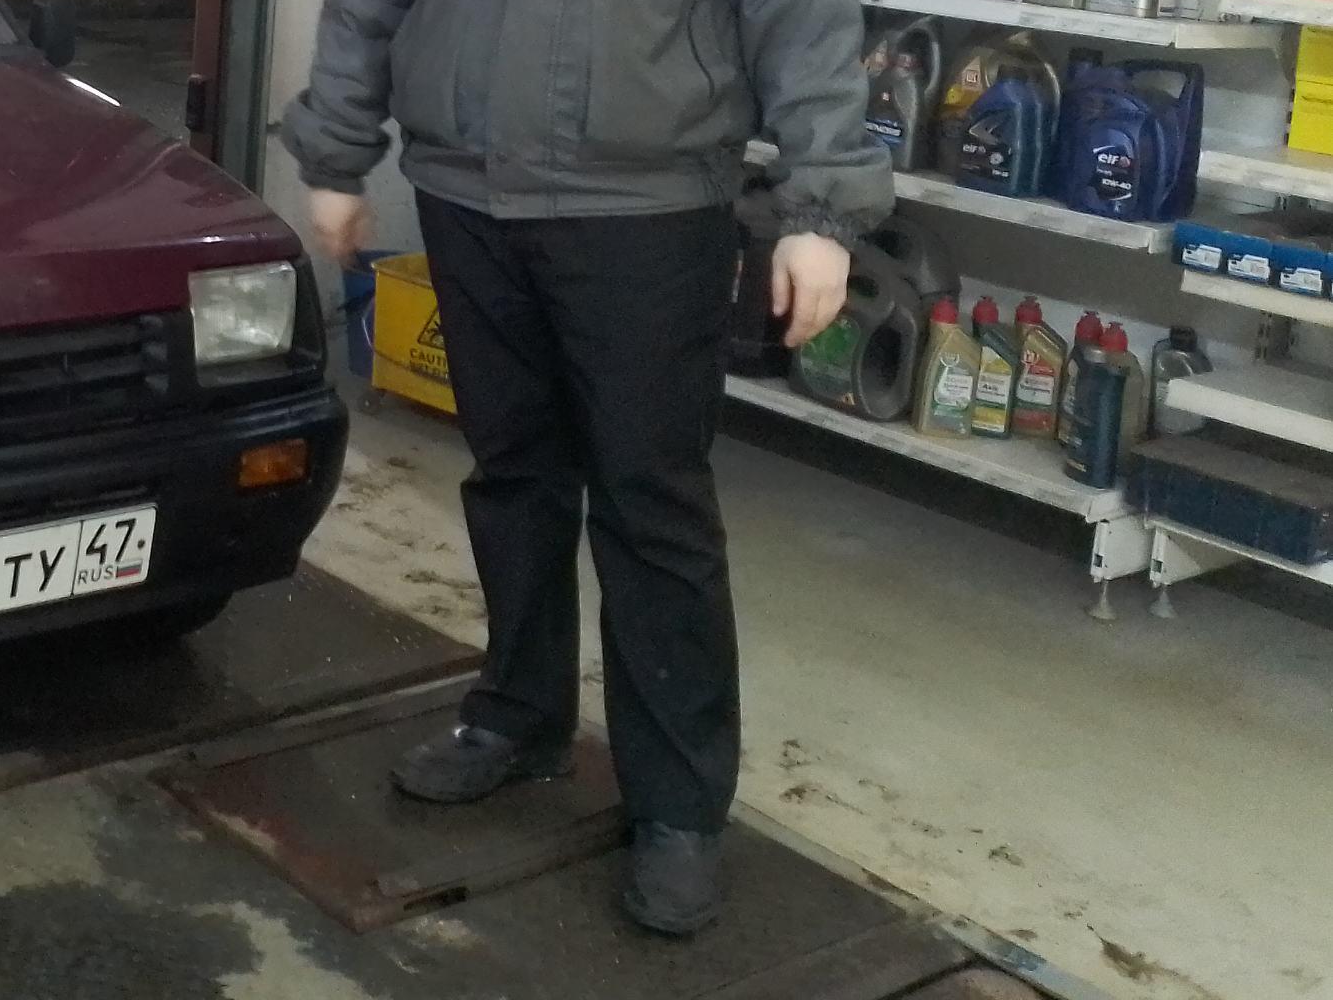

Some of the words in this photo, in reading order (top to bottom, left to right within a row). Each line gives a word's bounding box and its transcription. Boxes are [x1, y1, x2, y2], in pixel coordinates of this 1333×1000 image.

[410, 348, 448, 367] CAUTI
[85, 517, 138, 566] 47
[77, 564, 114, 586] RUS
